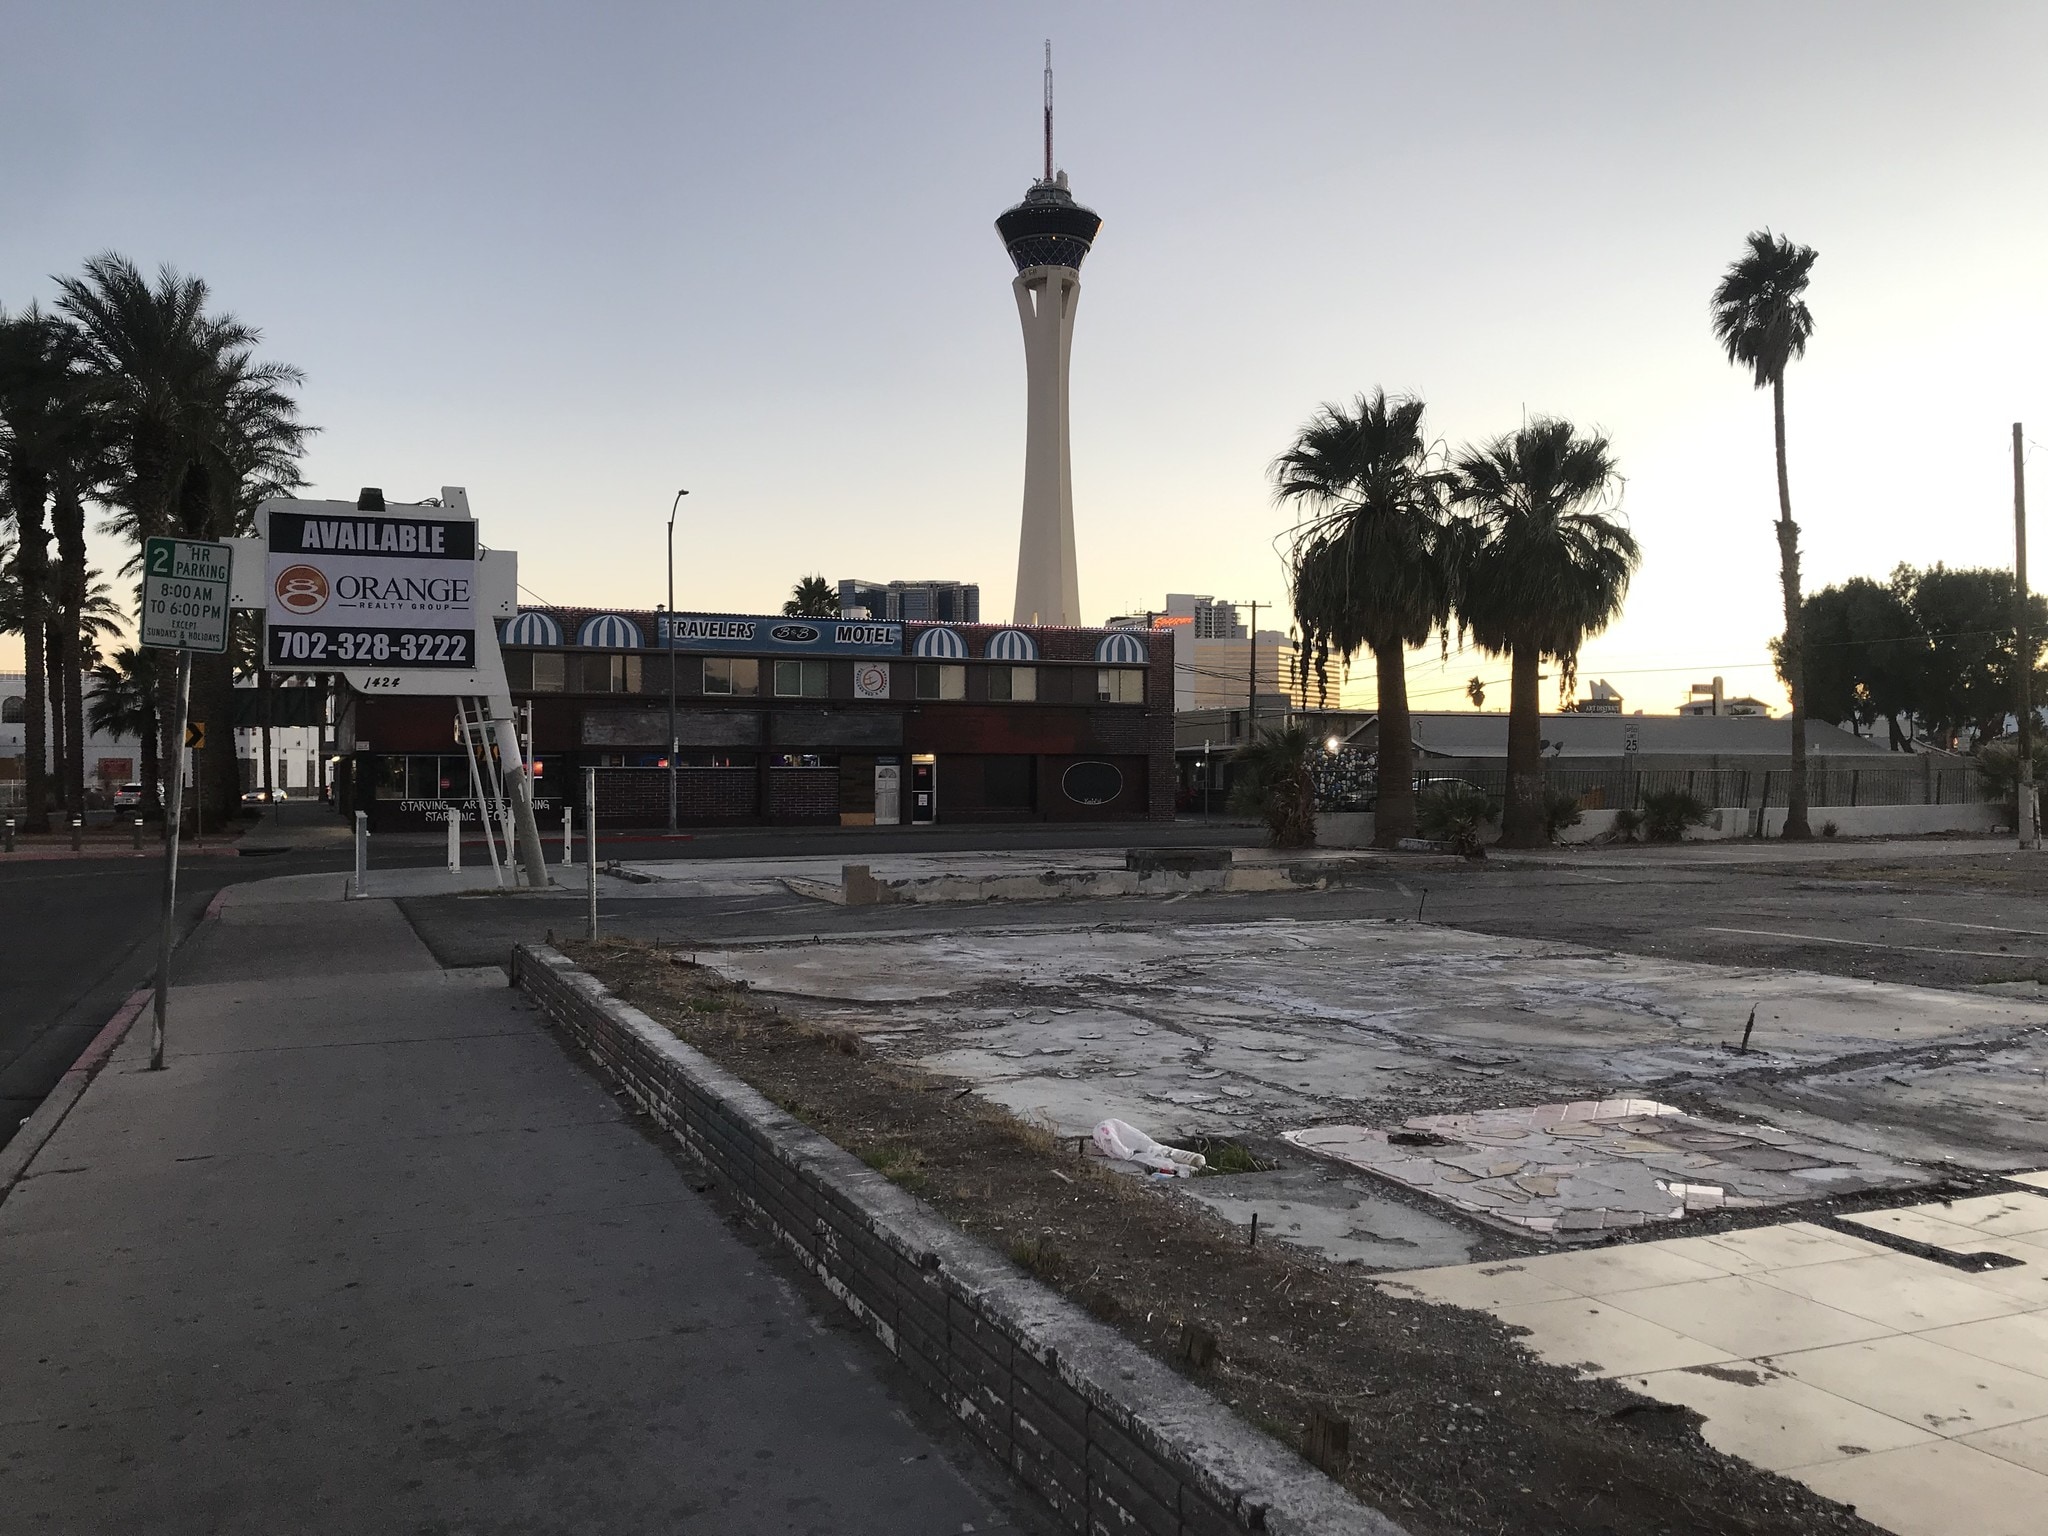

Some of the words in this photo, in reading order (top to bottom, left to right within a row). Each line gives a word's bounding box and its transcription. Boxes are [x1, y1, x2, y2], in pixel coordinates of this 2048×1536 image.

[301, 520, 445, 553] AVAILABLE
[152, 547, 169, 573] 2
[191, 547, 210, 562] HR
[176, 561, 225, 580] PARKING
[160, 583, 191, 599] 8:00
[193, 587, 213, 601] AM
[335, 575, 471, 603] ORANGE
[150, 599, 166, 614] TO
[170, 602, 200, 617] 6:00
[202, 605, 221, 619] PM
[359, 602, 403, 610] REALTY
[411, 603, 450, 611] GROUP
[171, 620, 197, 630] EXCEPT
[664, 621, 756, 640] TRAVELERS
[835, 625, 895, 644] MOTEL
[146, 627, 177, 639] SUNDAYS
[188, 632, 220, 643] HOLIDAYS
[277, 631, 467, 662] 702-328-3222
[363, 677, 401, 690] 1424
[1625, 739, 1638, 751] 25
[400, 800, 449, 812] STARVING
[462, 800, 506, 811] ARSTS
[425, 811, 476, 822] STARNG
